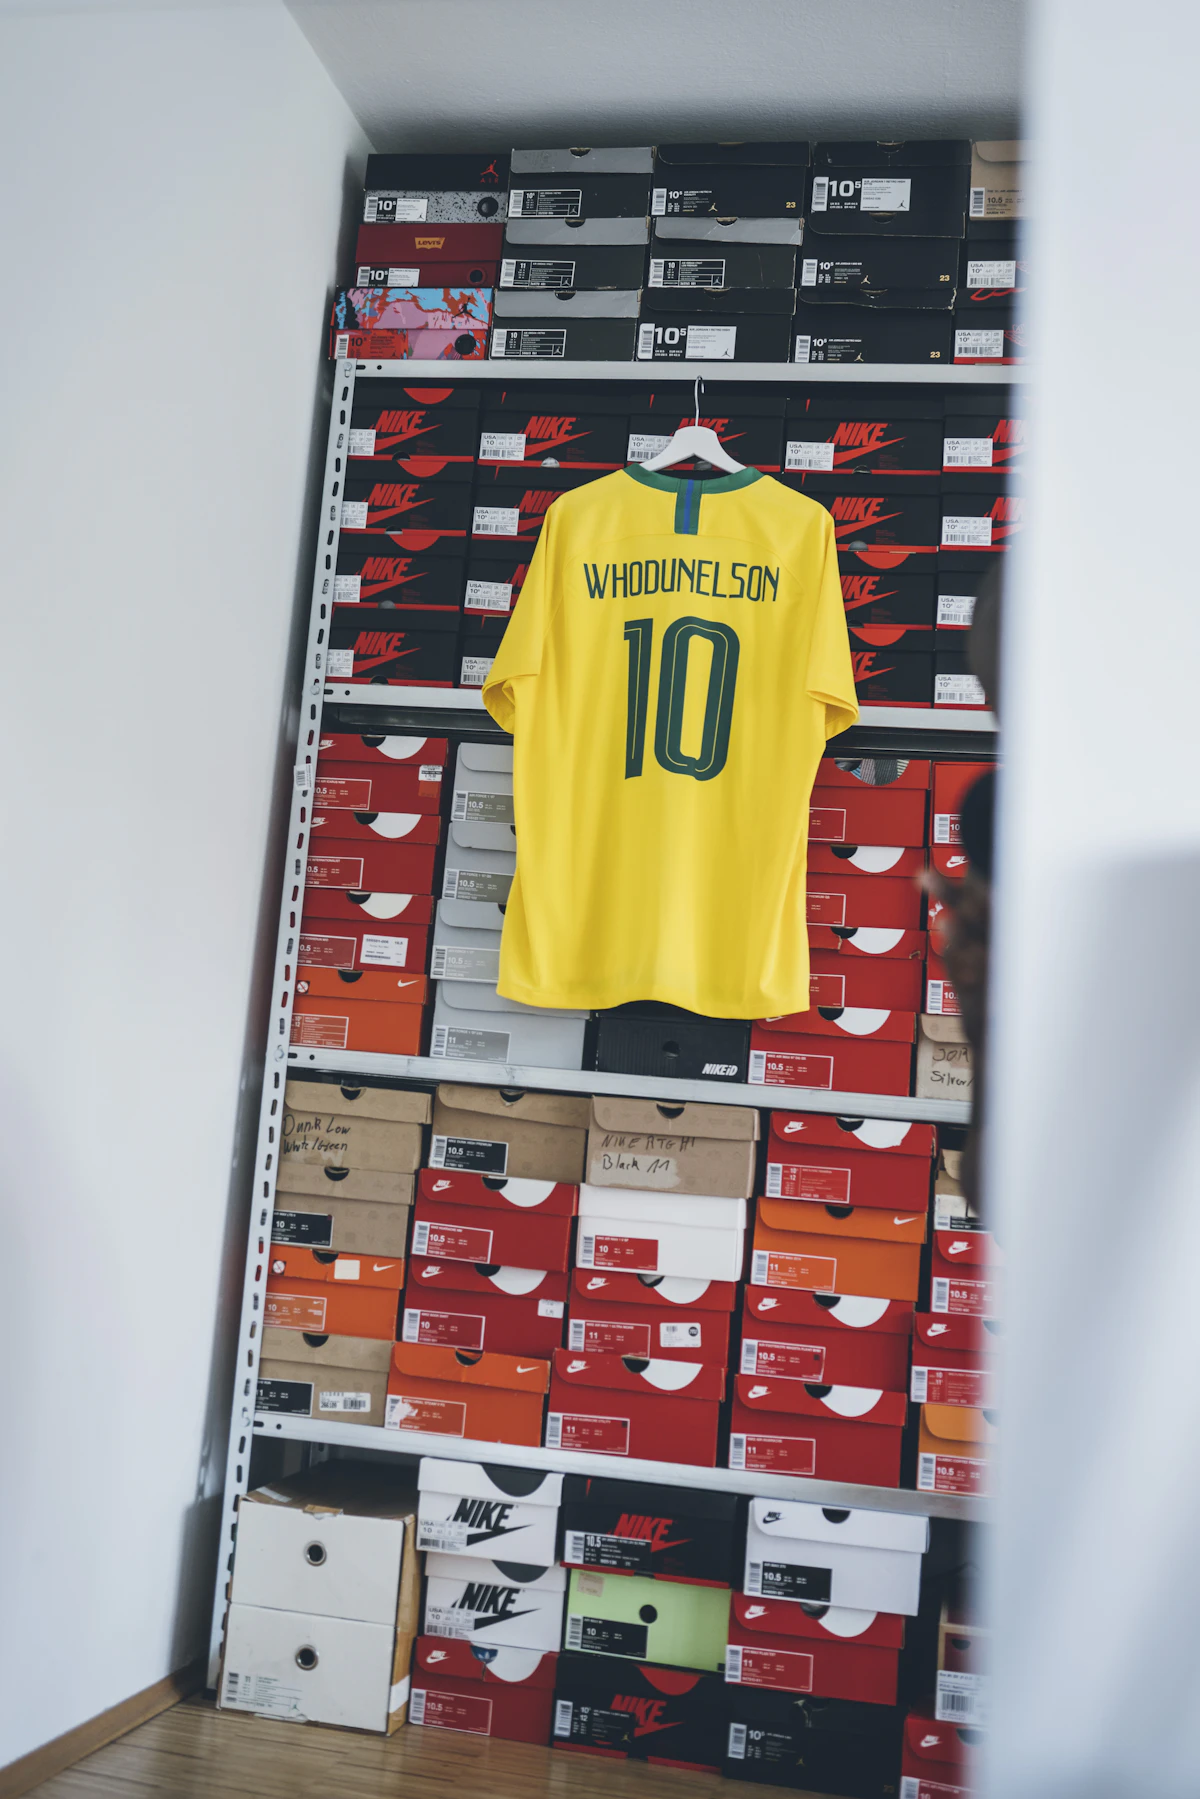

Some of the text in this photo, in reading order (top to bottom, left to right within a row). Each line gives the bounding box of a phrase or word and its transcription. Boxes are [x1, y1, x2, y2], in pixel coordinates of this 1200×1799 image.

[987, 196, 1003, 204] 10.5
[785, 201, 797, 209] 23
[375, 410, 426, 433] NIKE
[524, 416, 577, 439] NIKE
[832, 422, 888, 447] NIKE
[368, 483, 420, 507] NIKE
[830, 496, 885, 521] NIKE
[361, 557, 413, 580] NIKE
[583, 558, 779, 602] WHODUNELSON
[354, 631, 406, 655] NIKE
[623, 615, 740, 782] 10
[467, 801, 484, 809] 10.5
[458, 880, 475, 888] 10.5
[447, 956, 463, 965] 10.5
[766, 1062, 784, 1071] 10.5
[326, 1116, 351, 1135] Low
[789, 1120, 804, 1129] NIKE
[601, 1134, 641, 1149] NIKE
[447, 1146, 464, 1155] 10.5
[602, 1153, 640, 1171] Black
[275, 1220, 285, 1228] 10
[429, 1234, 445, 1243] 10.5
[598, 1245, 609, 1253] 10
[953, 1241, 969, 1249] NIKE
[426, 1265, 441, 1273] NIKE
[769, 1263, 779, 1271] 11
[950, 1290, 968, 1299] 10.5
[267, 1303, 277, 1311] 10
[420, 1321, 430, 1329] 10
[932, 1323, 947, 1331] NIKE
[758, 1352, 775, 1361] 10.5
[566, 1426, 576, 1434] 11
[746, 1446, 757, 1454] 11
[936, 1466, 955, 1476] 10.5
[452, 1498, 514, 1532] NIKE
[613, 1513, 673, 1544] NIKE
[586, 1535, 601, 1548] 10.5
[763, 1572, 782, 1582] 10.5
[458, 1582, 521, 1616] NIKE
[750, 1605, 766, 1613] NIKE
[586, 1627, 596, 1636] 10
[432, 1650, 447, 1658] NIKE
[743, 1659, 753, 1667] 11
[426, 1702, 443, 1712] 10.5
[610, 1694, 668, 1725] NIKE
[580, 1714, 588, 1722] 12
[925, 1735, 940, 1743] NIKE
